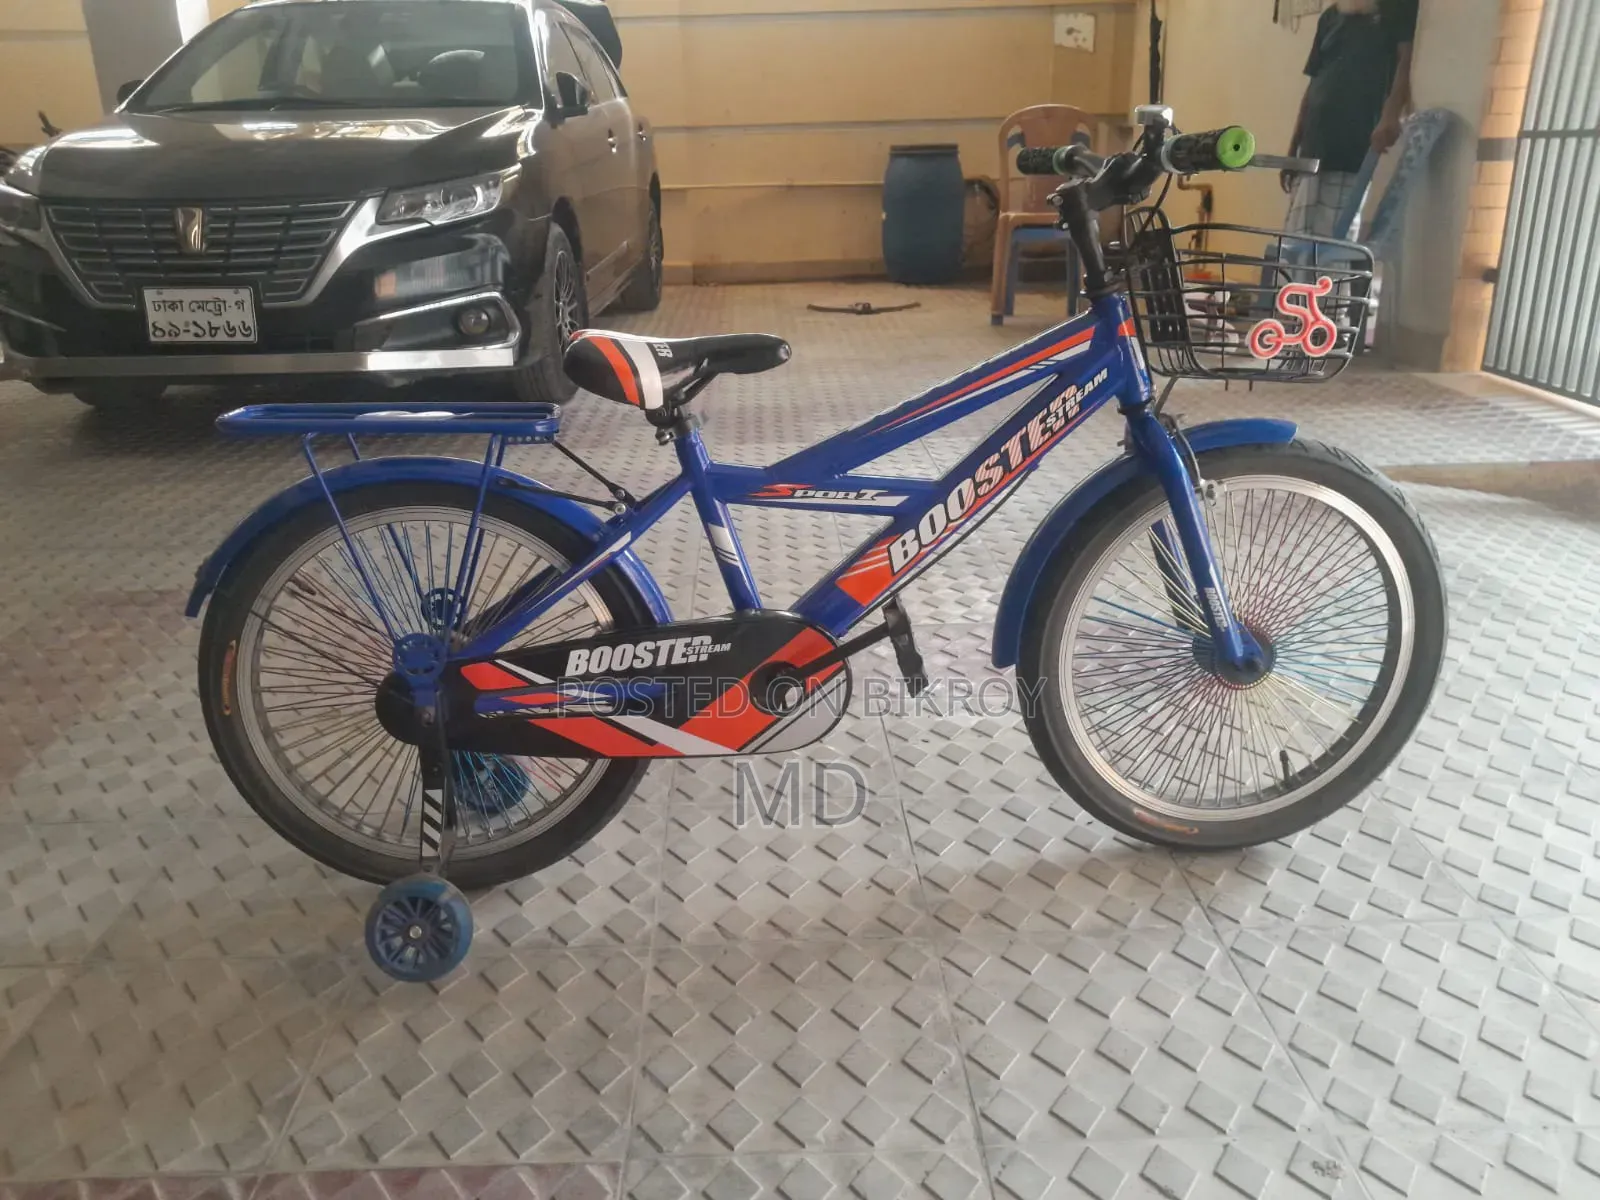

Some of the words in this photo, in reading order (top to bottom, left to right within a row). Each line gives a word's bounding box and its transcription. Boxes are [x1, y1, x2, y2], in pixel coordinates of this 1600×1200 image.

[151, 300, 184, 313] ঢাকা
[1045, 367, 1108, 428] STREAM
[887, 383, 1080, 576] BOOSTER
[564, 635, 713, 678] BOOSTER
[686, 643, 732, 655] STREAM
